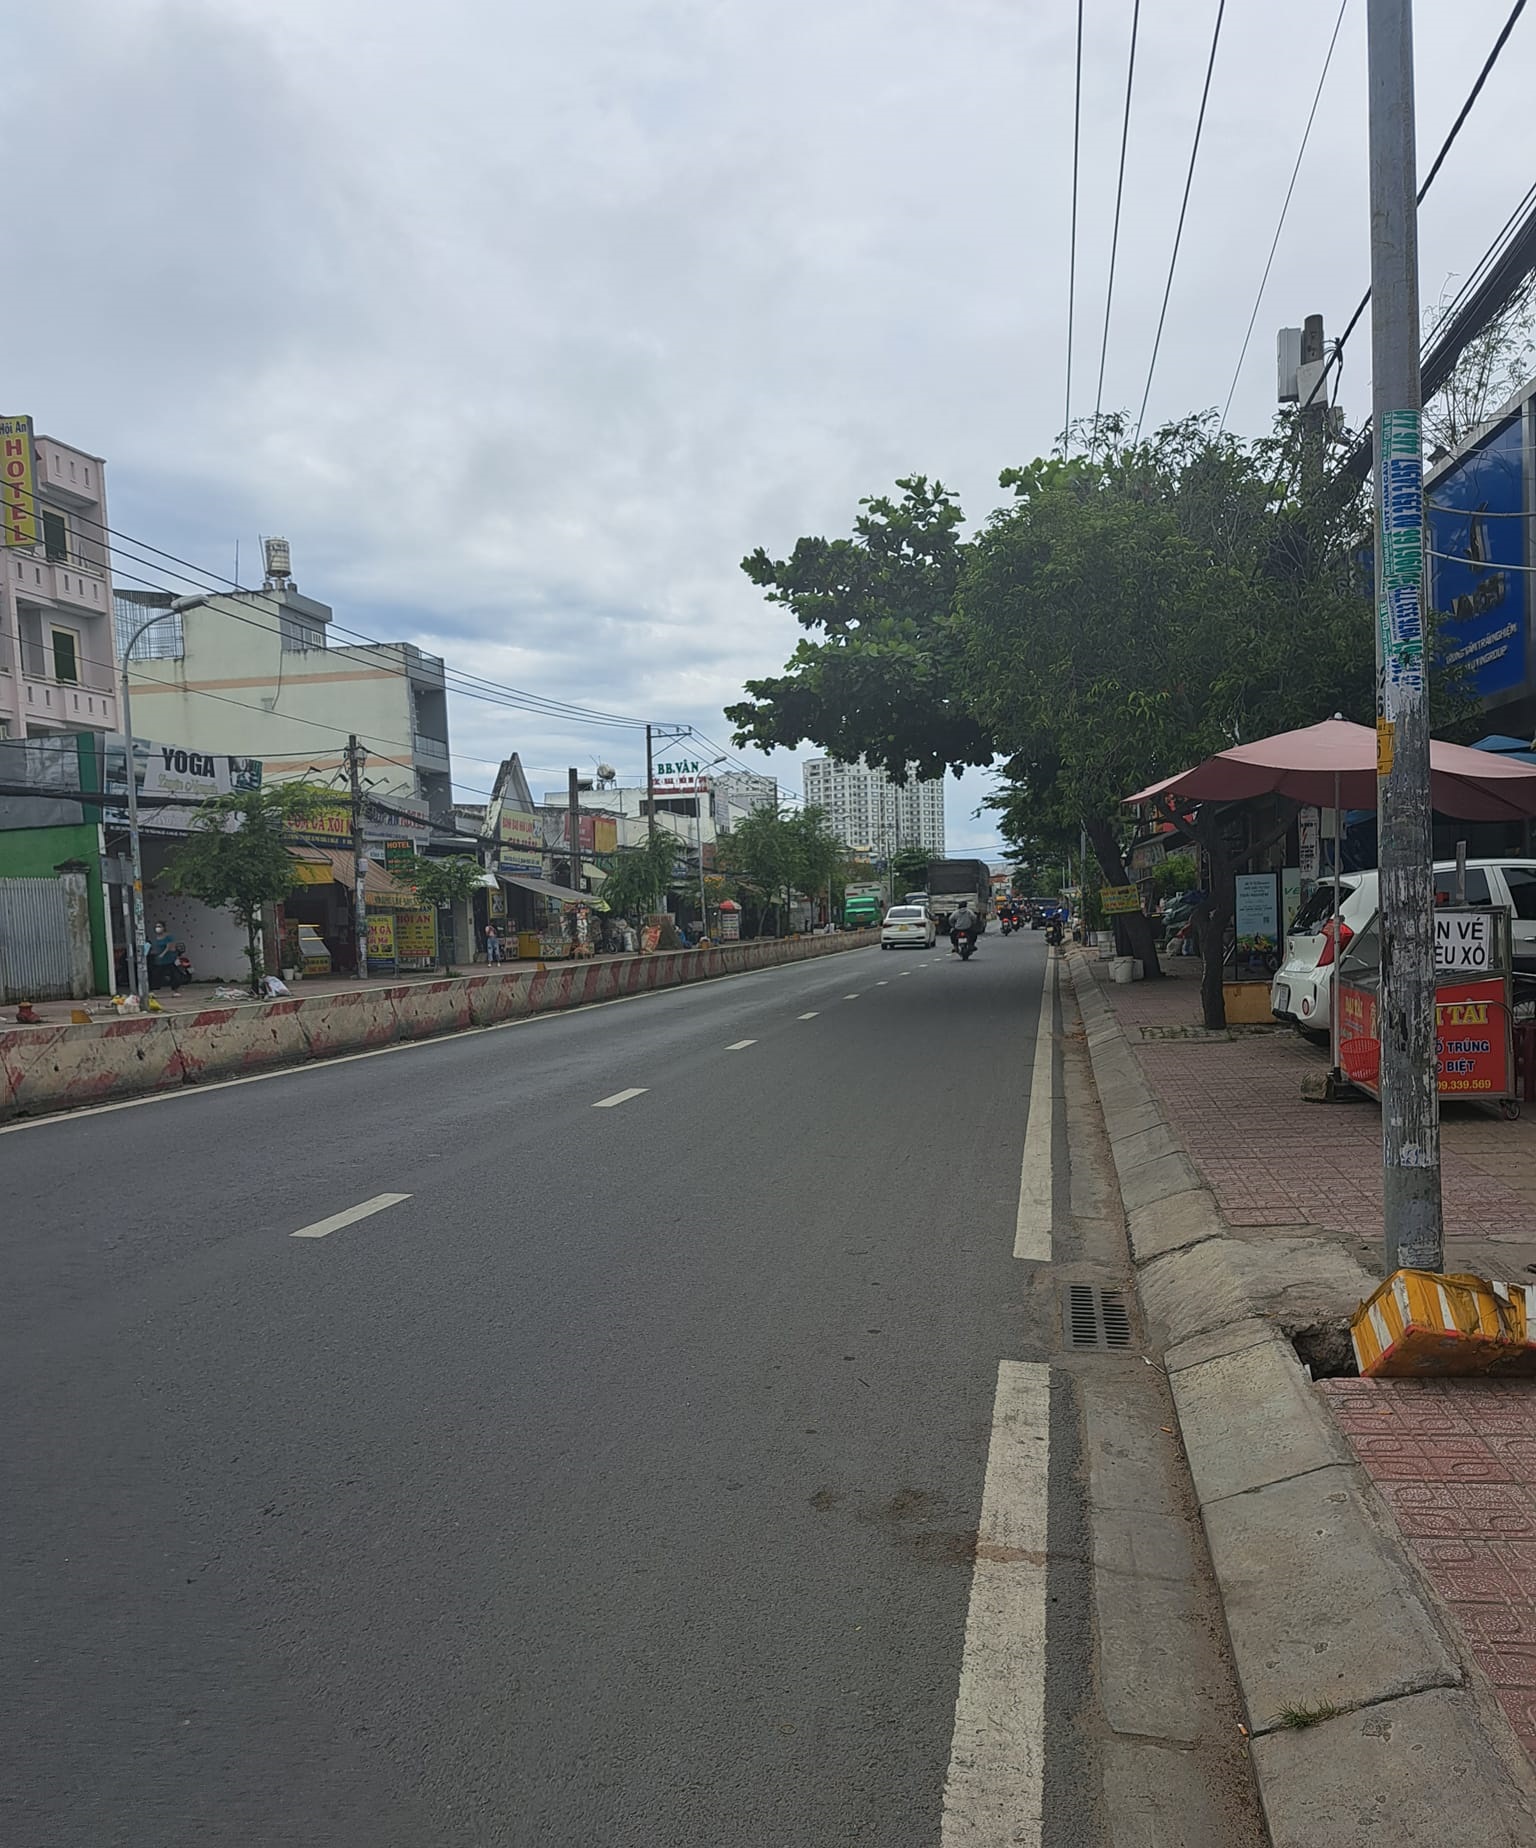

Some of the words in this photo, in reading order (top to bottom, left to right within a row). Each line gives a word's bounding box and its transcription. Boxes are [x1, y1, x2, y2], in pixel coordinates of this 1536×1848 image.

[15, 421, 27, 433] An
[1392, 432, 1420, 455] 446
[1391, 460, 1421, 492] 34567
[5, 438, 28, 542] HOTEL
[1392, 493, 1422, 513] 359
[1392, 514, 1422, 528] 08
[1393, 529, 1421, 545] 66
[1396, 602, 1419, 618] 533
[1398, 617, 1421, 639] 0976
[161, 747, 215, 778] YOGA
[657, 758, 700, 775] BB.VÂN
[386, 840, 411, 849] HOTEL
[1457, 916, 1484, 940] VÉ
[1447, 1037, 1490, 1053] TRÚNG
[1446, 1057, 1475, 1076] BIỆT
